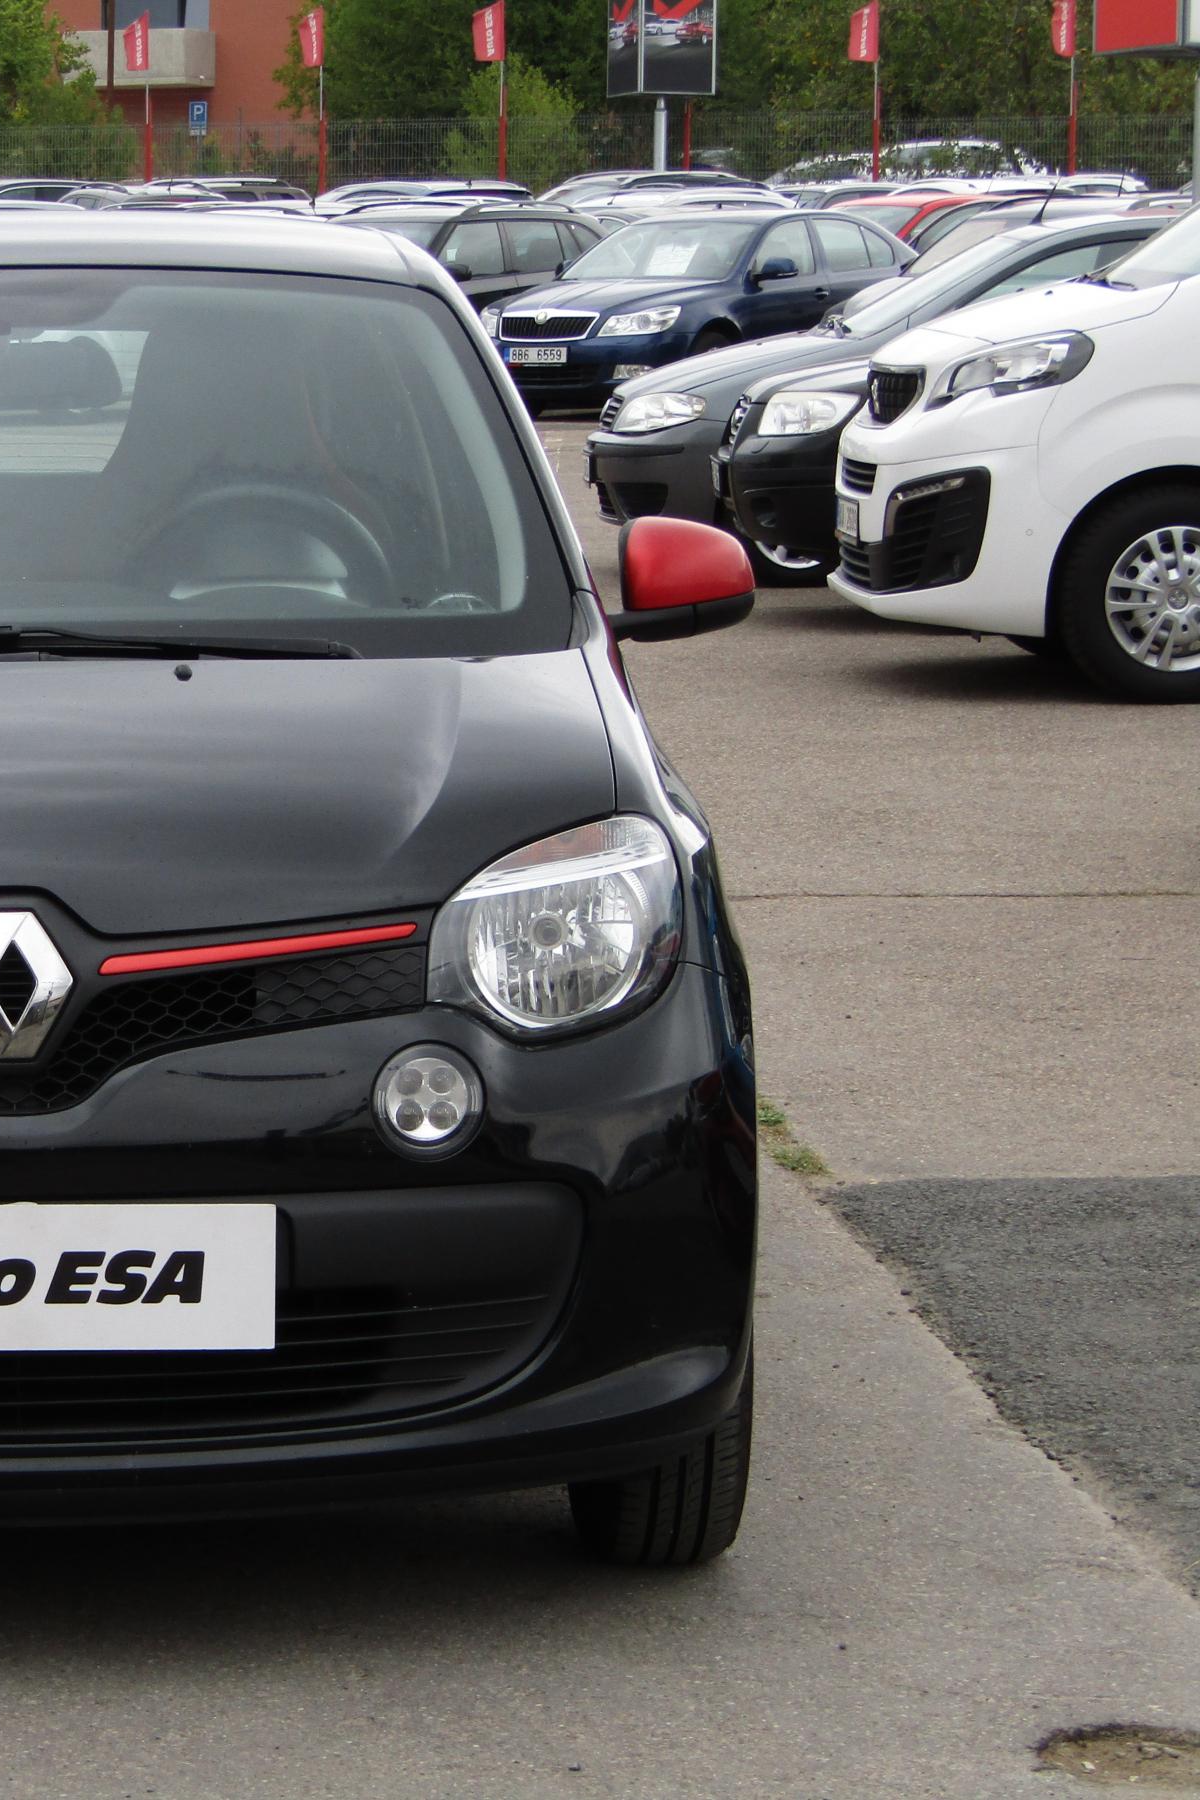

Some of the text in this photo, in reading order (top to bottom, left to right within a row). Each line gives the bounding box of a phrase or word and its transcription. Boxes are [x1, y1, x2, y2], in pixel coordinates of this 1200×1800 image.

[193, 104, 204, 120] P
[536, 348, 563, 361] 6559
[44, 1249, 205, 1305] ESA
